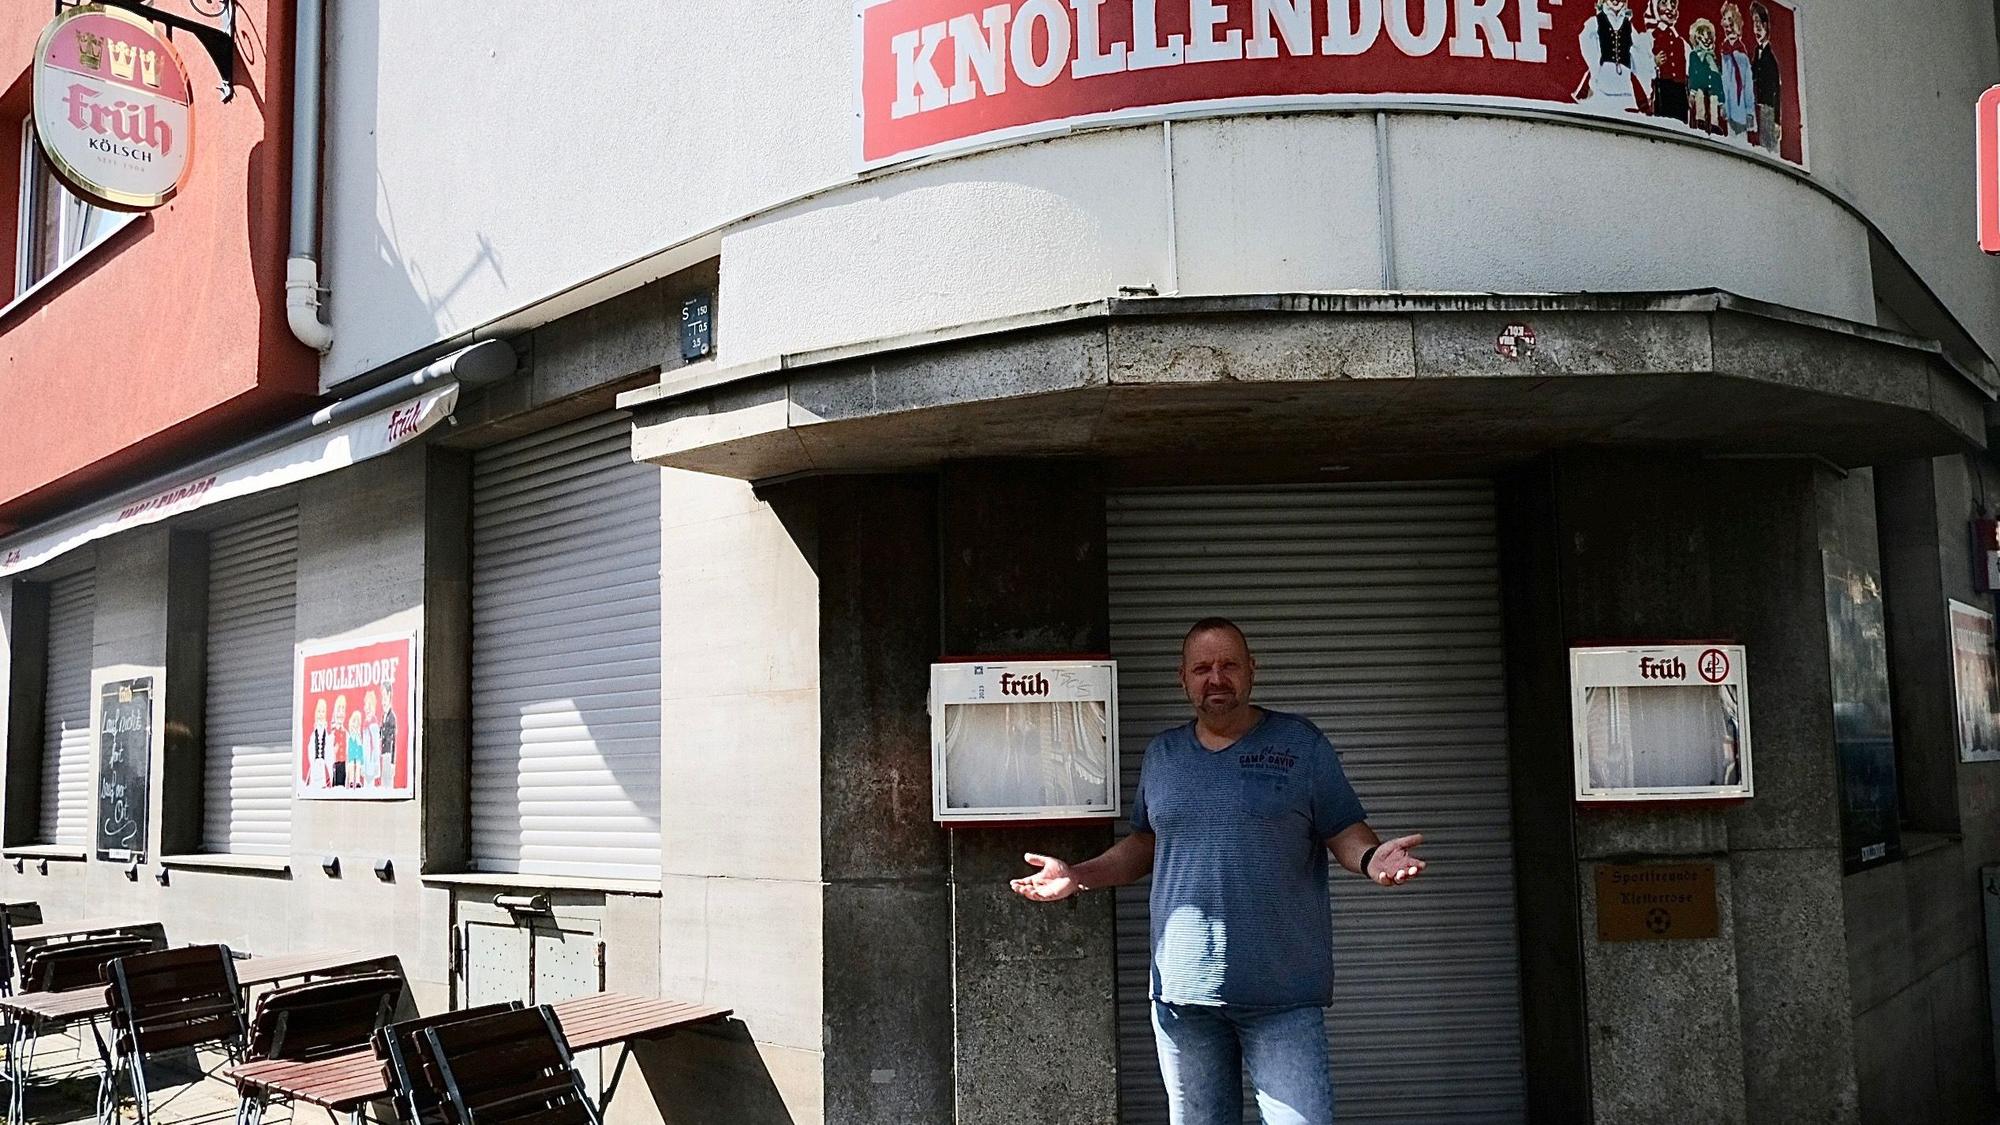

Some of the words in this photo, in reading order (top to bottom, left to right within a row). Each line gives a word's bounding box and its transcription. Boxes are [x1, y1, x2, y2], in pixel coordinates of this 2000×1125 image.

[890, 0, 1563, 119] KNOLLENDORF
[89, 137, 152, 163] KÖLSCH
[682, 307, 689, 320] S
[310, 656, 399, 693] KNOLLENDORF
[1239, 754, 1265, 764] CAMP
[1267, 755, 1295, 769] DAVID
